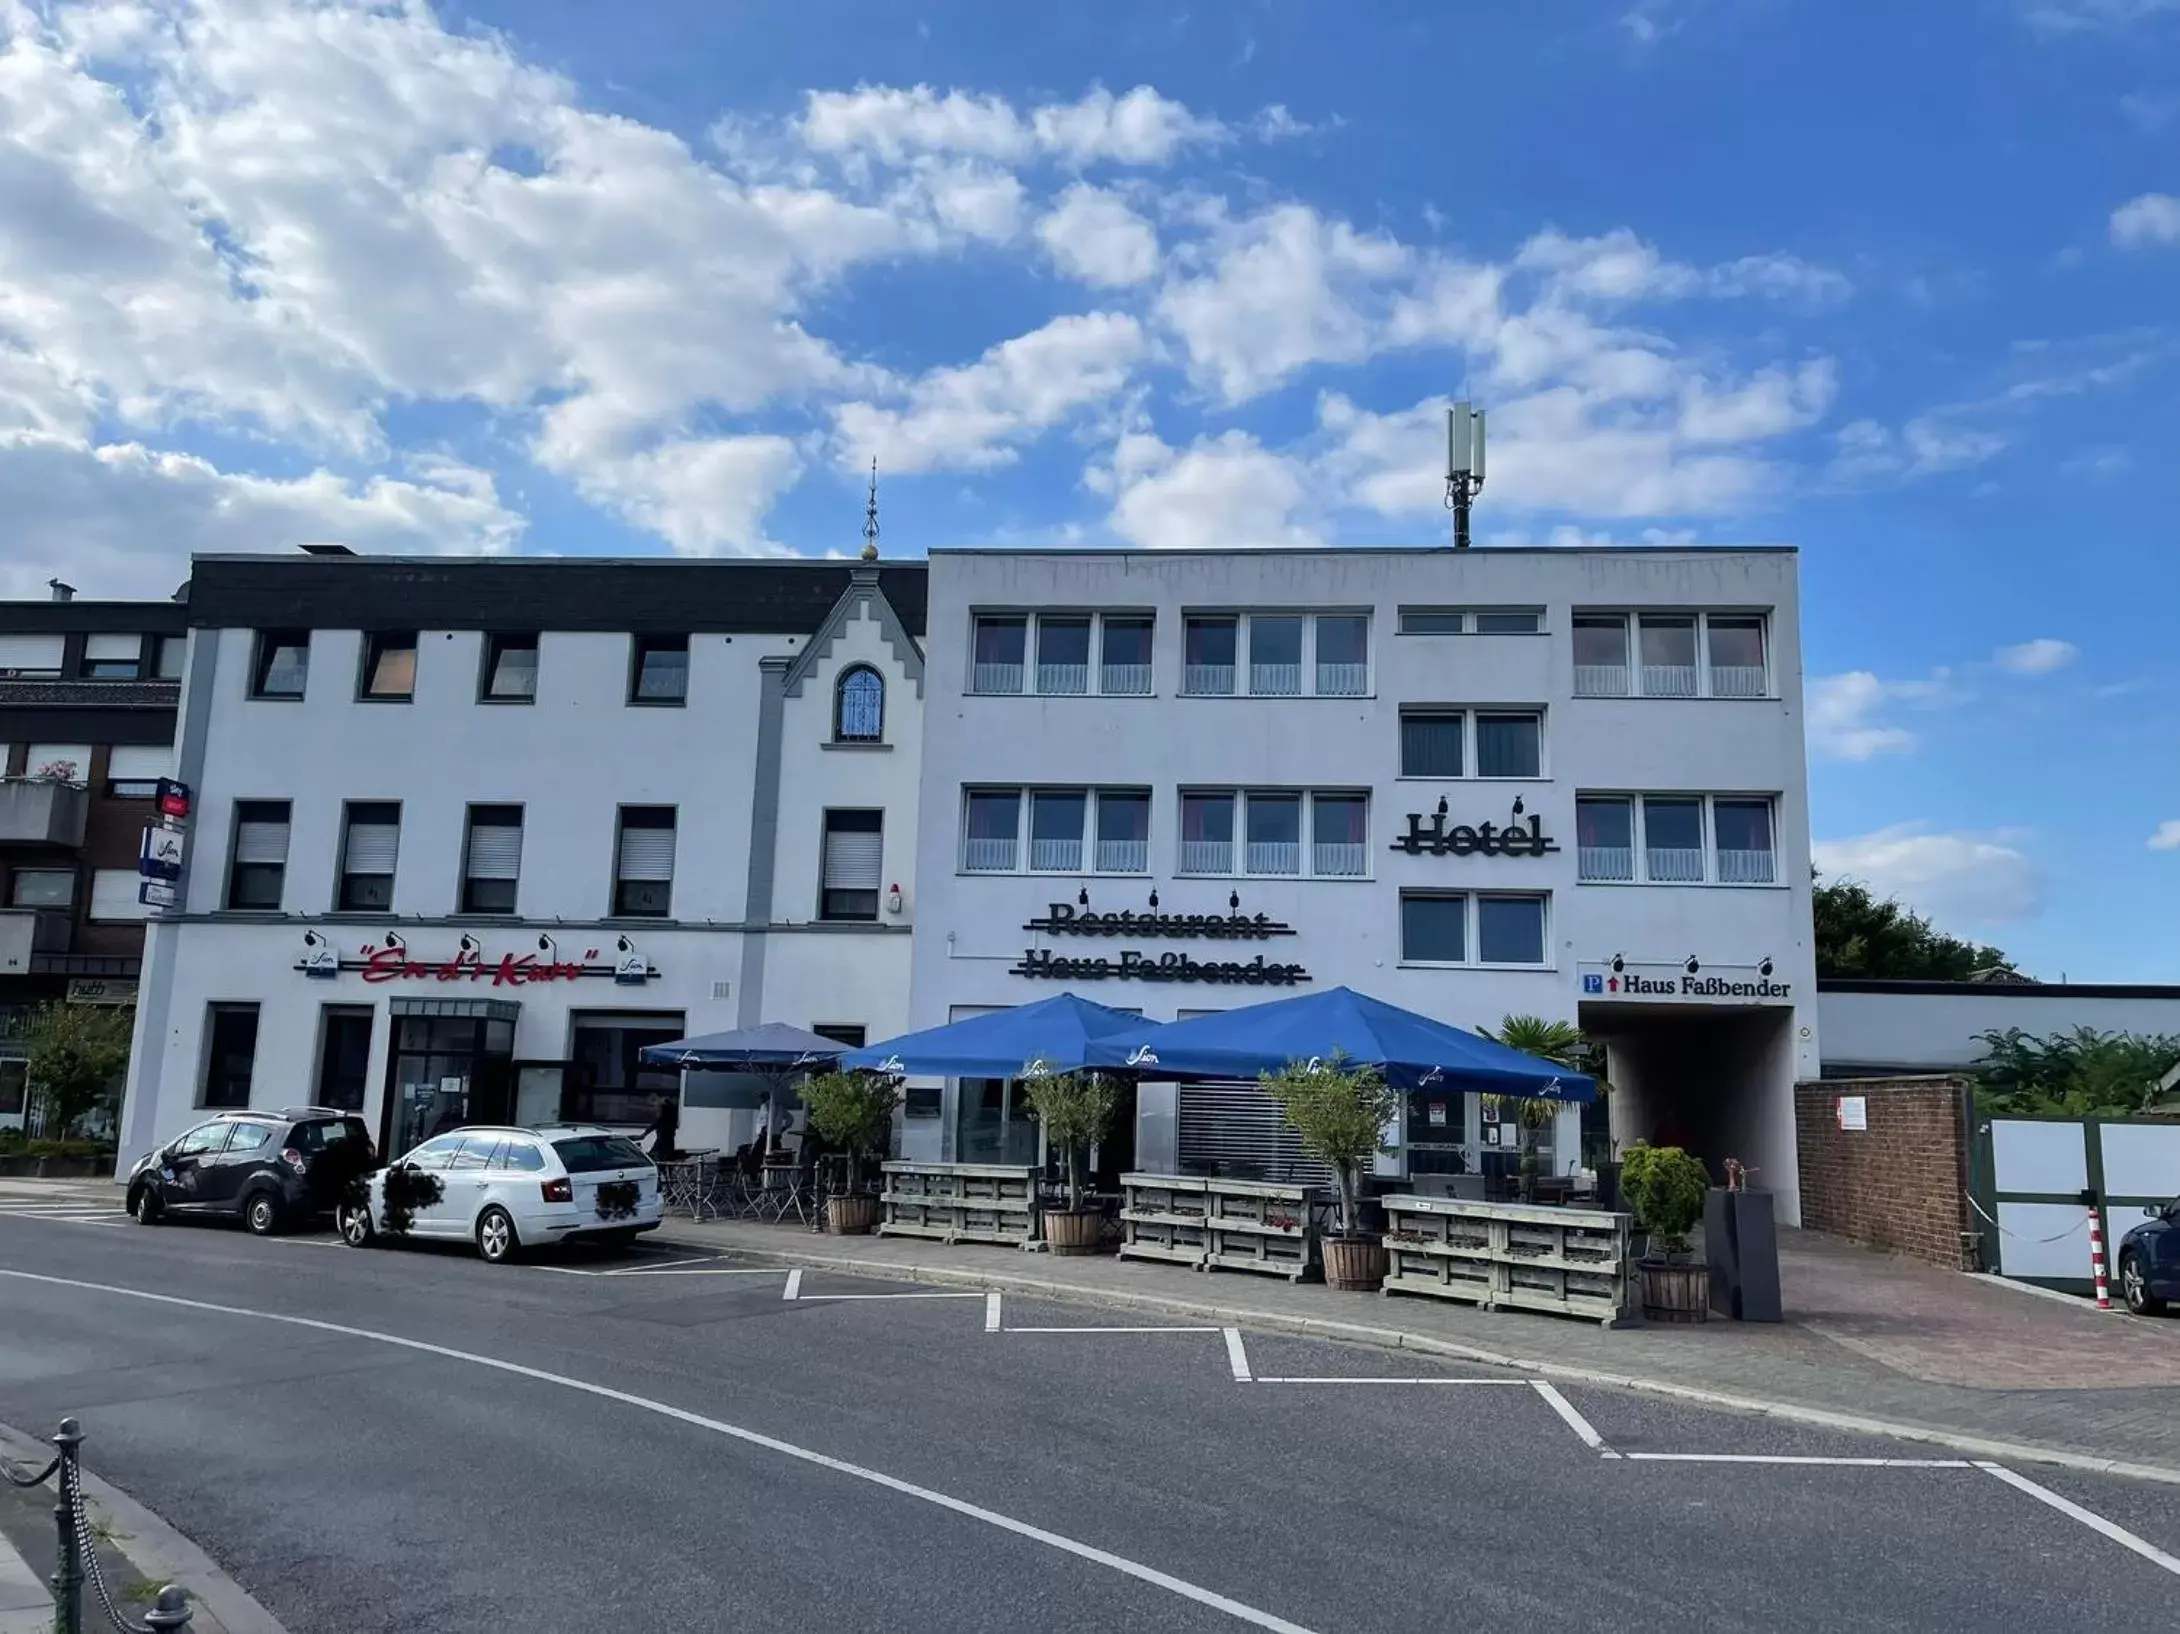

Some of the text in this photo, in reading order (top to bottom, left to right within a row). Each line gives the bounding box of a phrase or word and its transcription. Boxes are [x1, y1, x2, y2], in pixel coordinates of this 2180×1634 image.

[1406, 813, 1546, 857] Hotel
[1047, 903, 1270, 939] Restaurant
[1023, 949, 1300, 985] Haus Faßbender
[1624, 975, 1676, 994] Haus
[1682, 976, 1791, 998] Faßbender
[1125, 1044, 1160, 1066] Sion
